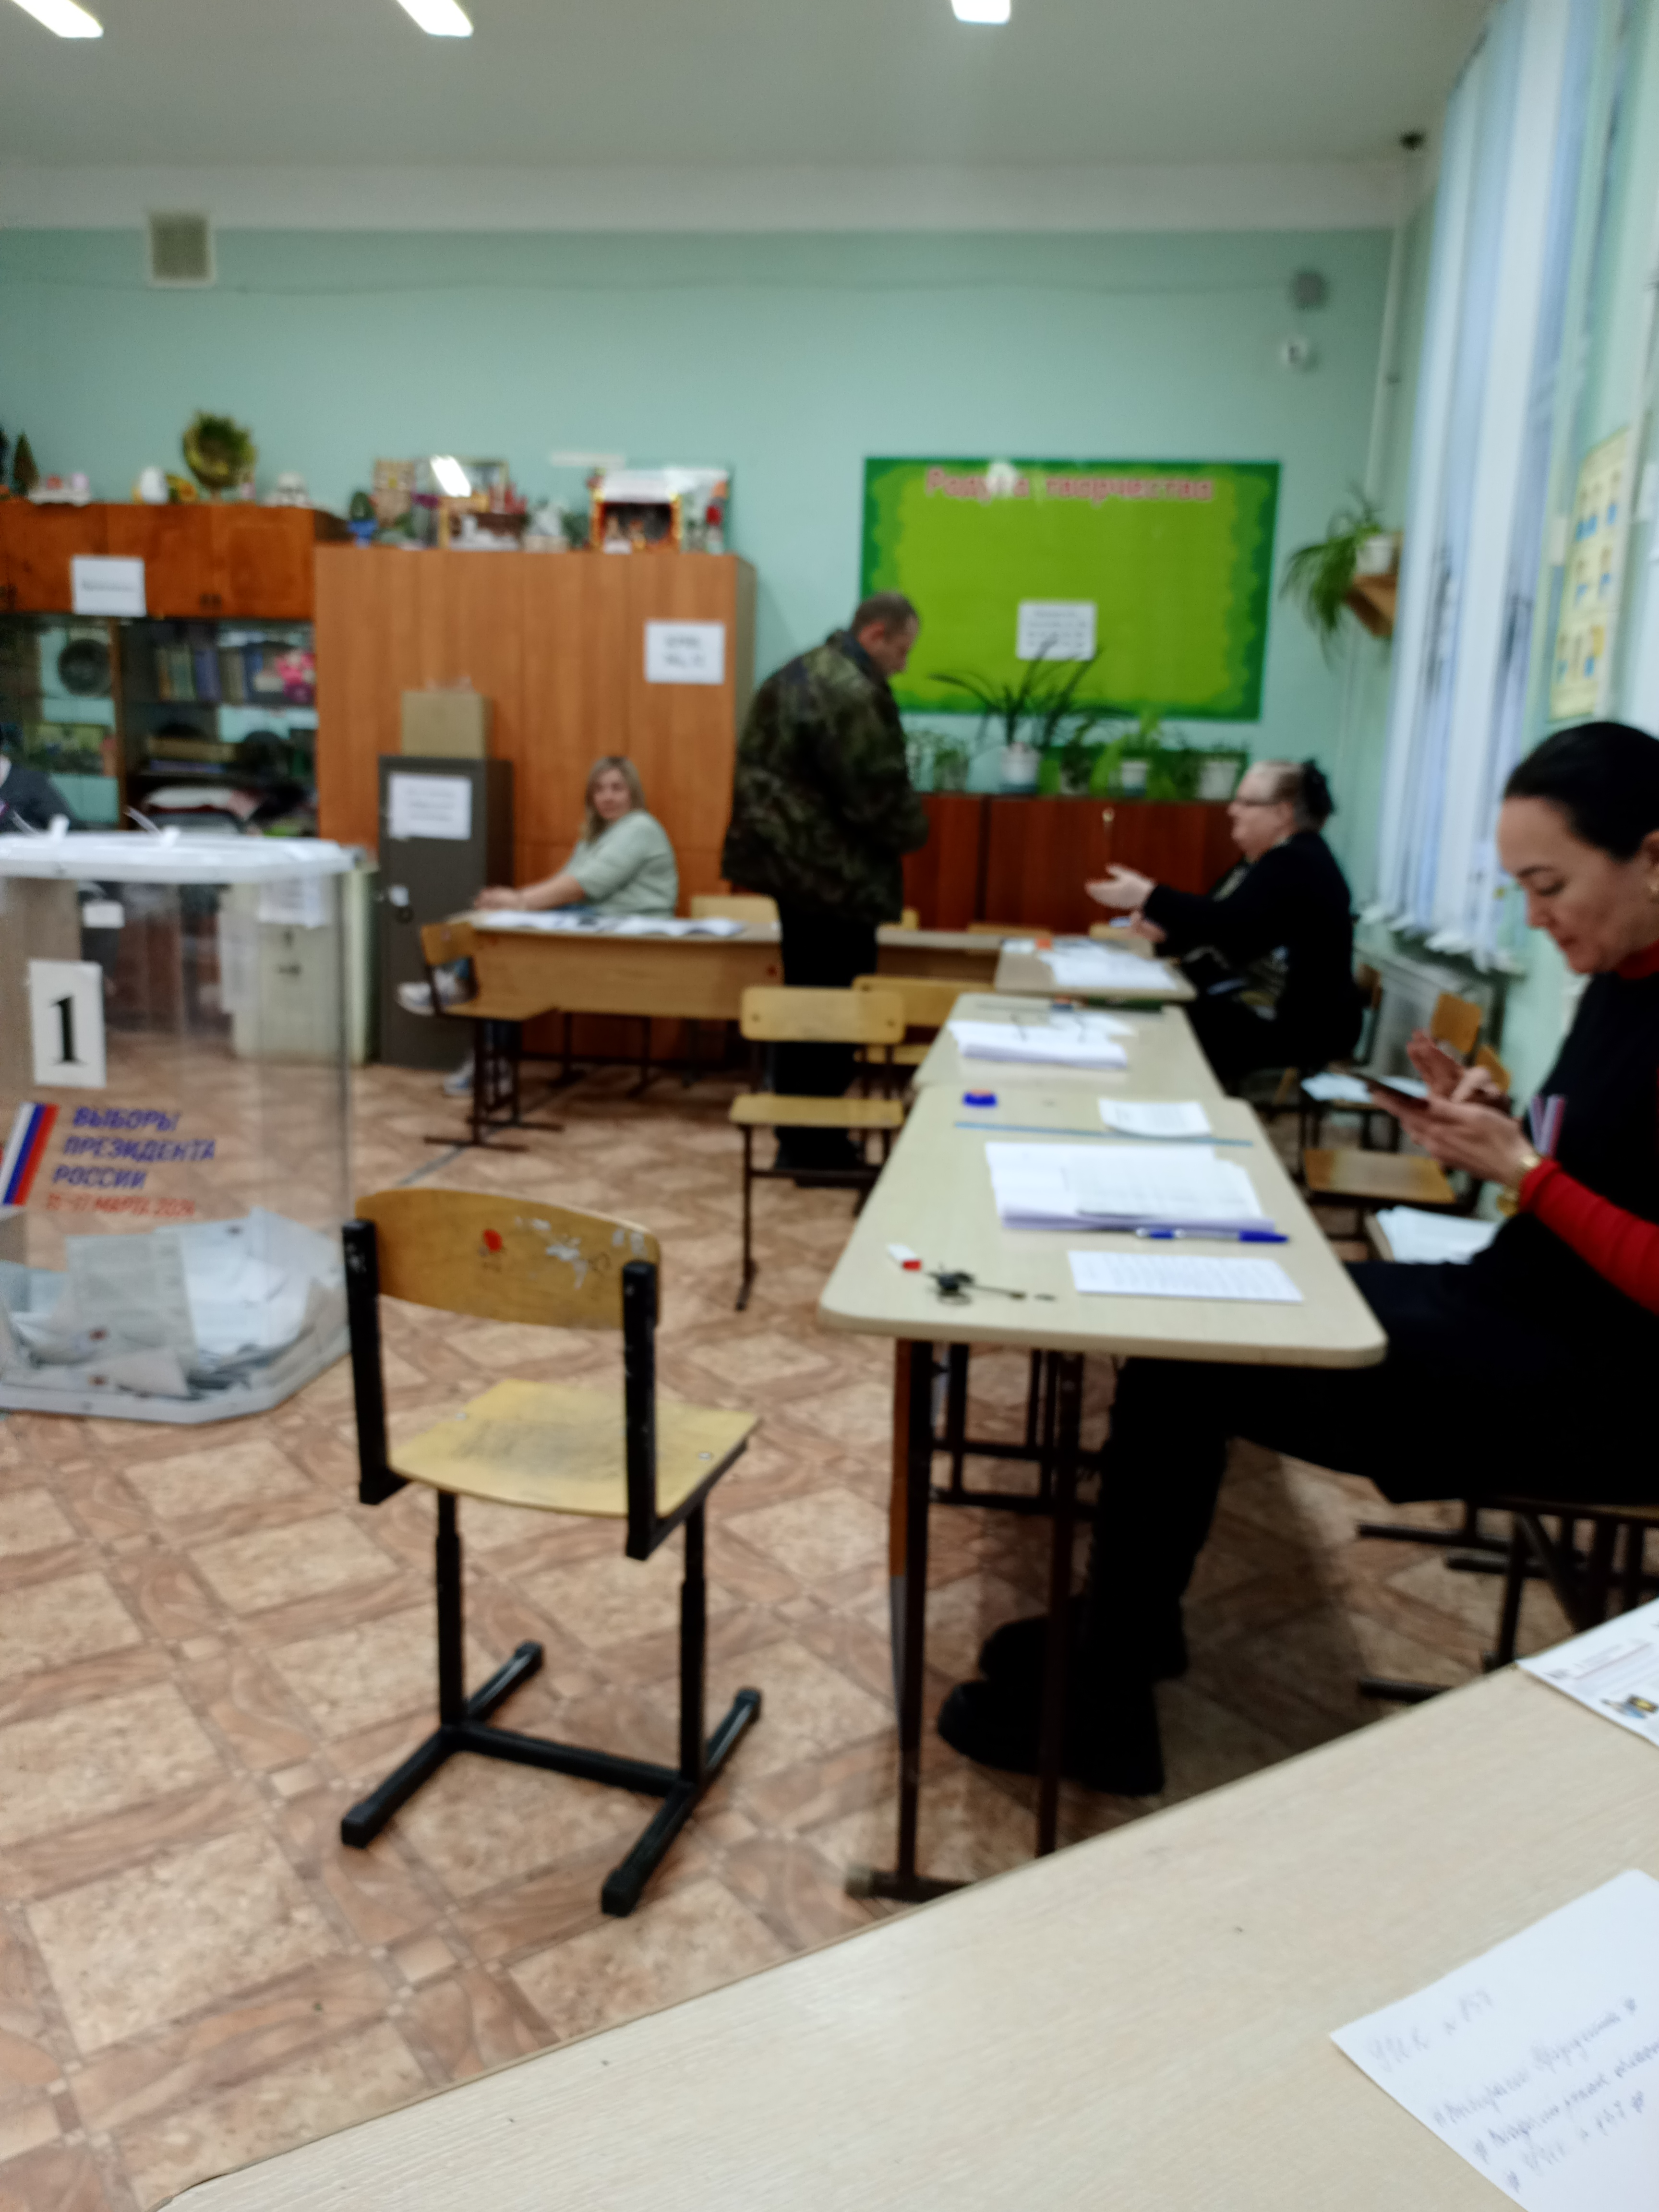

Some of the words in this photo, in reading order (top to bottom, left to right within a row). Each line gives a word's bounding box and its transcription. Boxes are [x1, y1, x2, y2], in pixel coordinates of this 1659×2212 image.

[926, 468, 1029, 504] Радуа
[49, 994, 86, 1066] 1
[73, 1106, 181, 1132] ВЫБОРЫ
[63, 1136, 216, 1162] ПРЕЗИДЕНТА
[52, 1165, 146, 1189] РОССИИ
